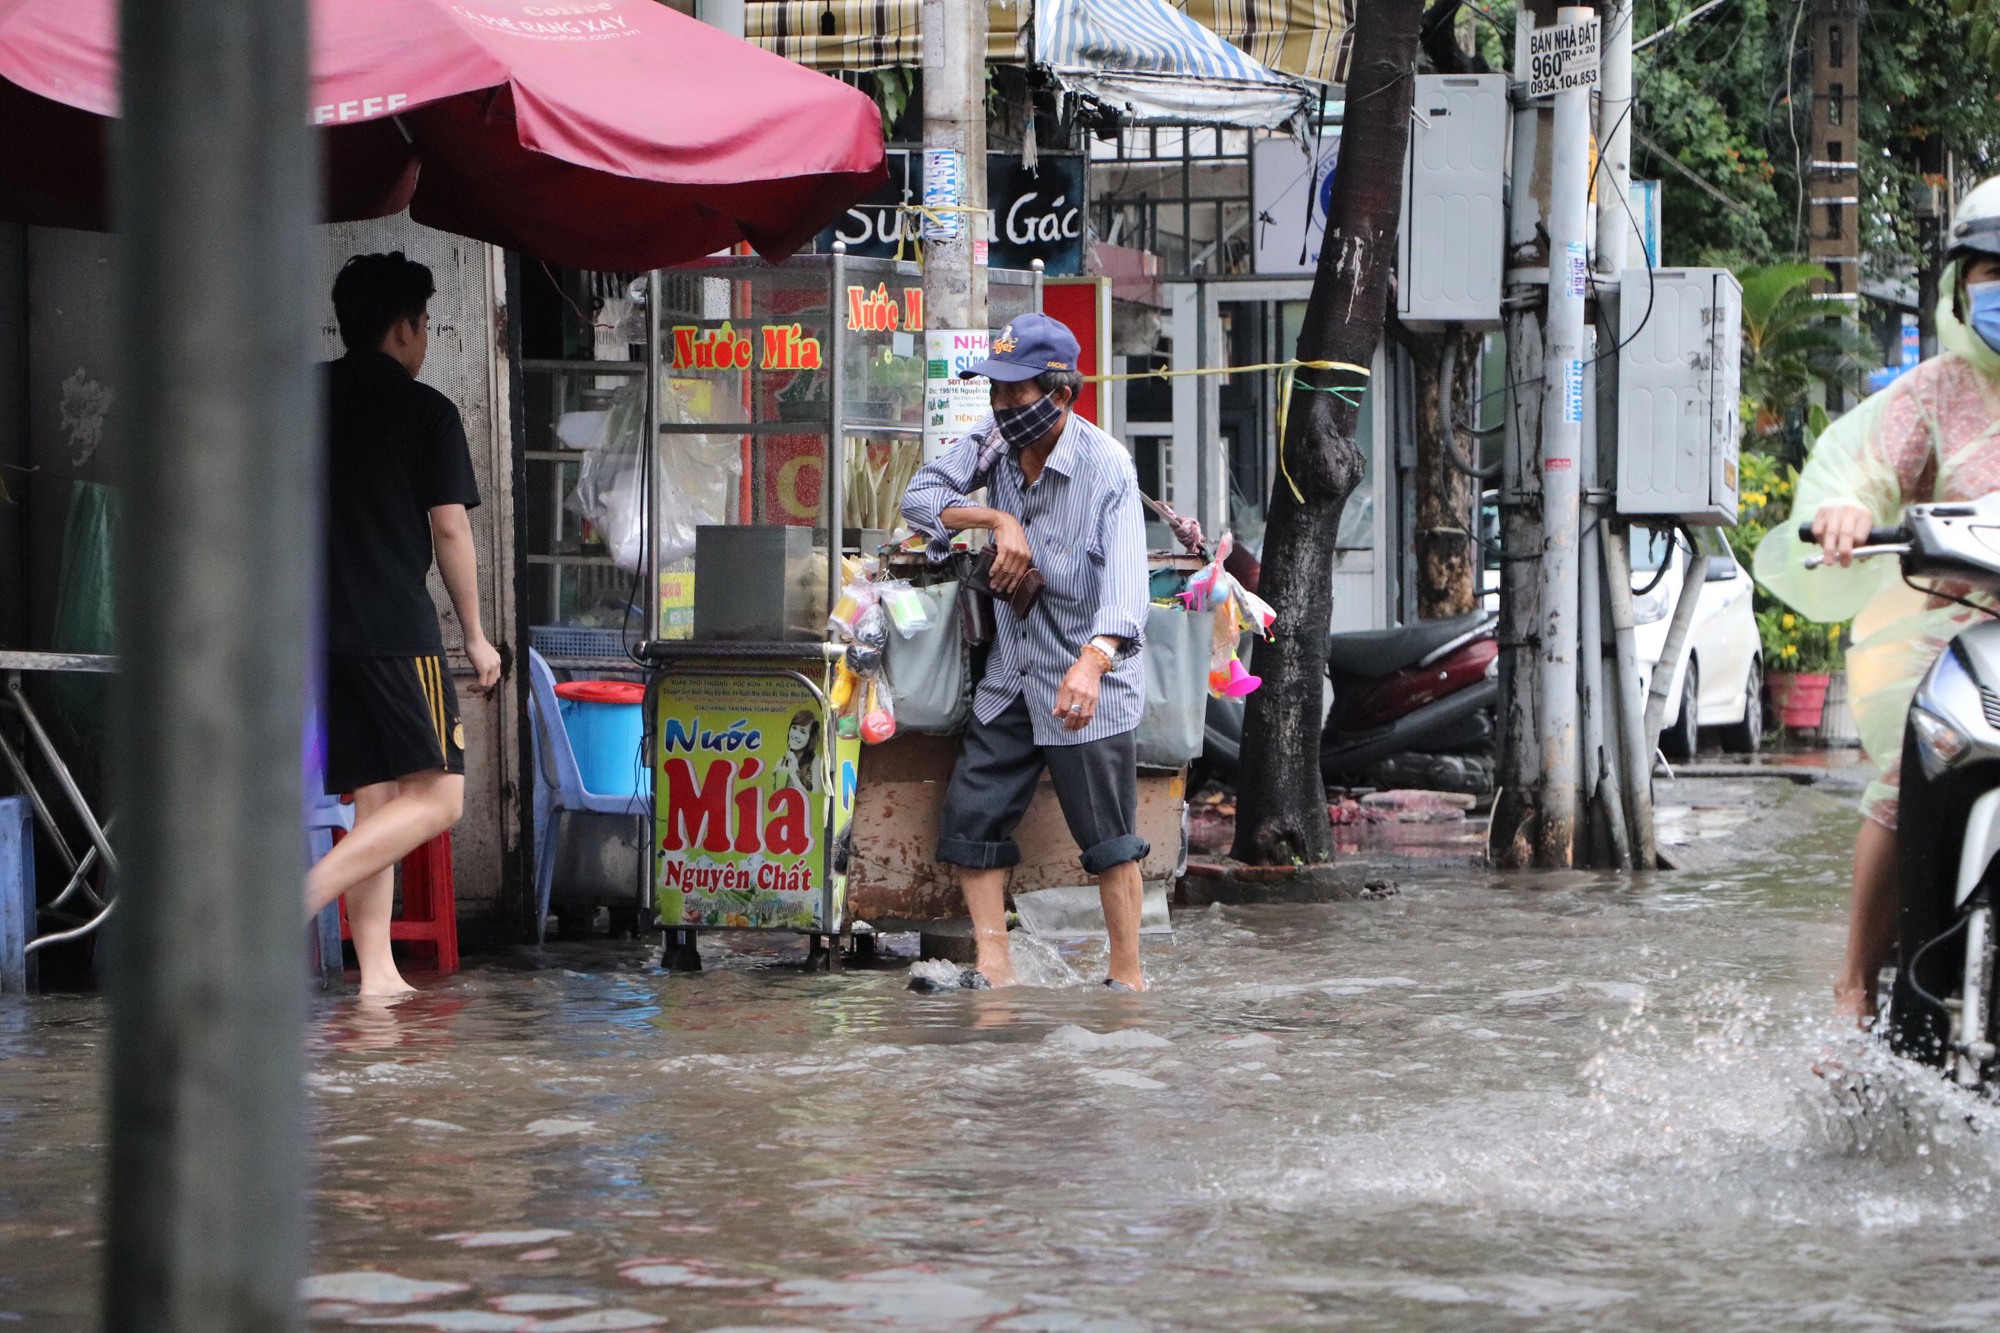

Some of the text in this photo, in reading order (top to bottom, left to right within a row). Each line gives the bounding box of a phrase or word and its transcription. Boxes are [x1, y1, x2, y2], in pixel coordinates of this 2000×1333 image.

[518, 20, 581, 34] RANG
[578, 15, 627, 32] XAY
[1531, 30, 1552, 55] BÁN
[1554, 24, 1577, 51] NHÀ
[1531, 69, 1597, 94] 0934.104.853
[847, 282, 899, 331] Nước
[672, 321, 822, 370] Nước Mía
[664, 717, 762, 754] Nước
[662, 757, 815, 856] Mía
[664, 859, 813, 896] Nguyên Chất
